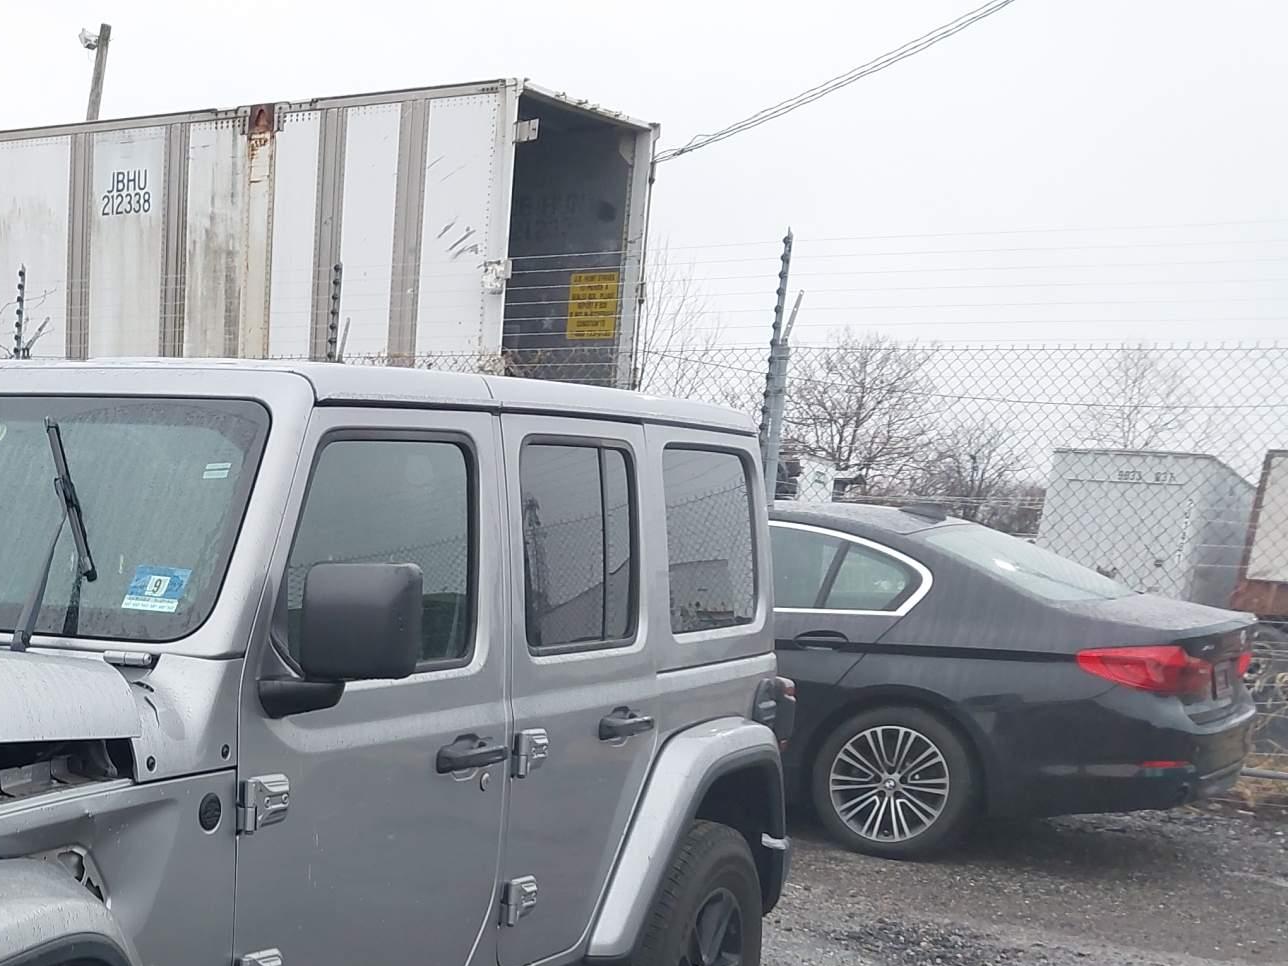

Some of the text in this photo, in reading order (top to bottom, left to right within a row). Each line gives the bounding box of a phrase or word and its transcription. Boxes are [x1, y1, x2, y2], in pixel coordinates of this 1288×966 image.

[107, 168, 148, 194] JBHU
[101, 191, 151, 216] 212338
[152, 578, 162, 593] 9
